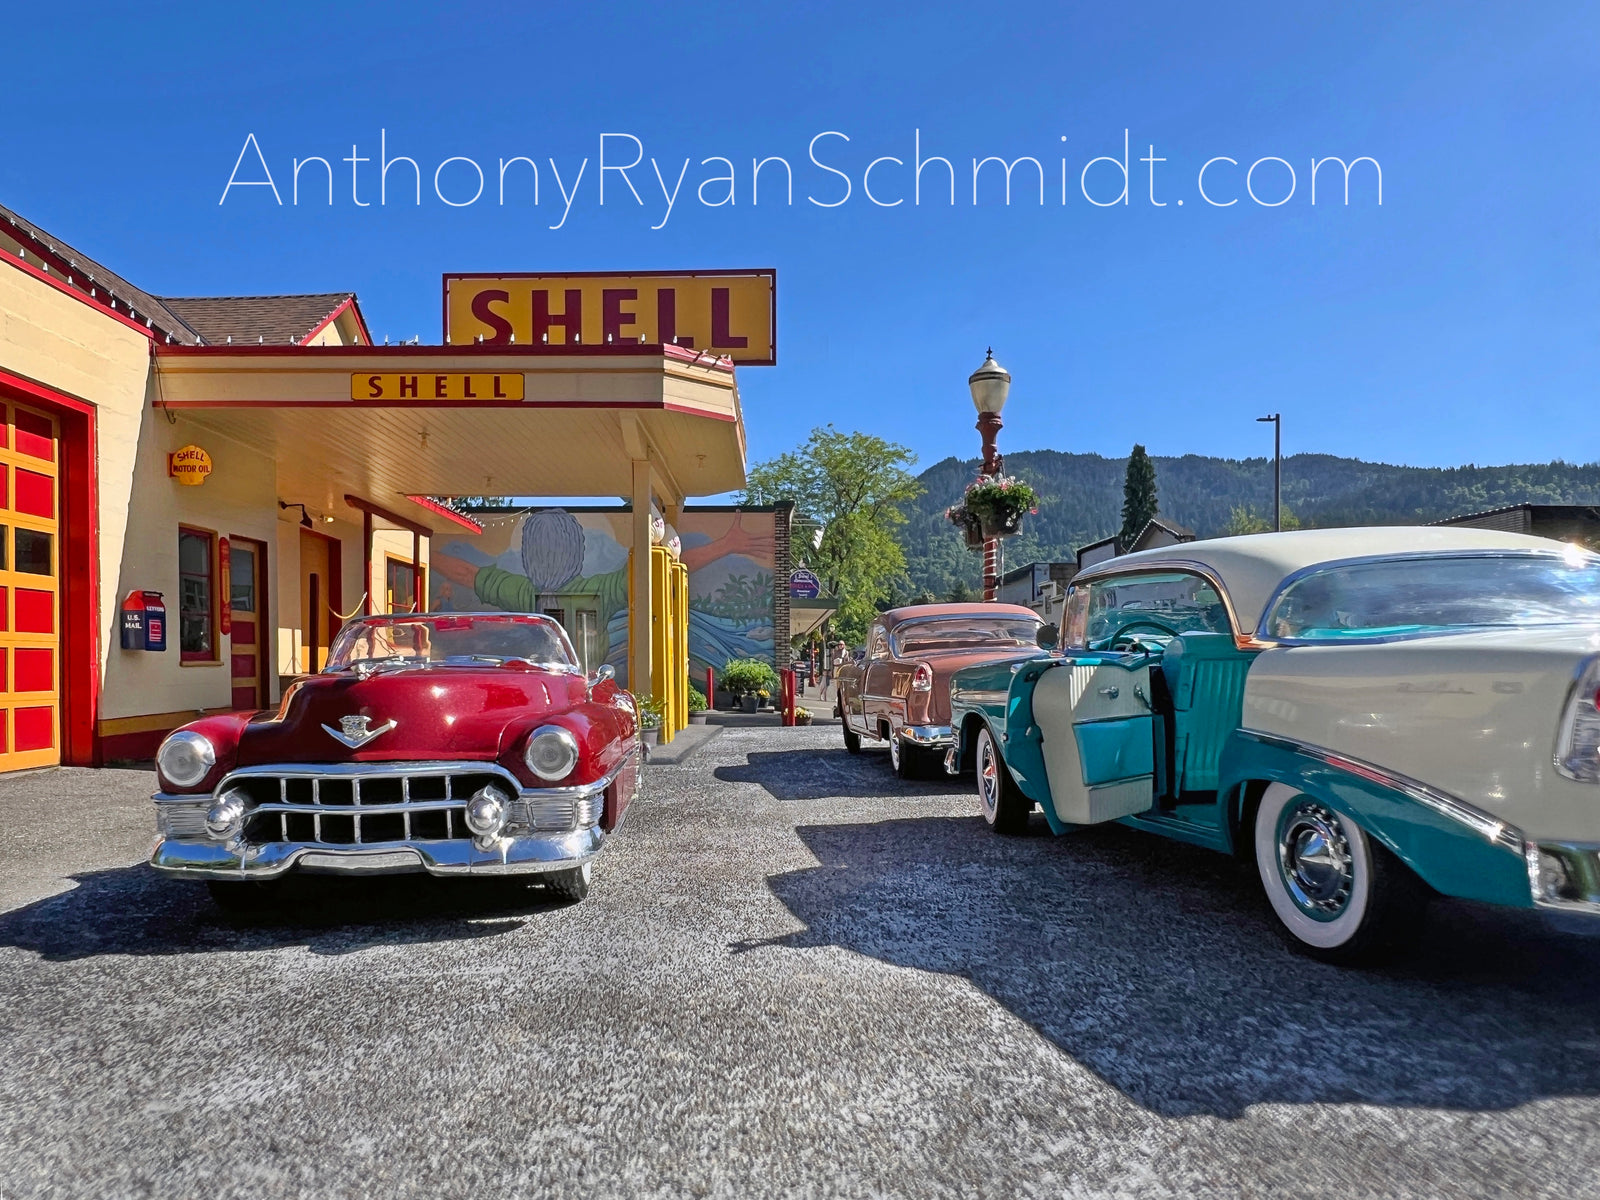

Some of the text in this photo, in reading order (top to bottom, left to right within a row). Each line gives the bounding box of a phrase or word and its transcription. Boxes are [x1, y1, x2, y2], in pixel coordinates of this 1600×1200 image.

[471, 287, 748, 348] SHELL
[368, 375, 507, 398] SHELL
[177, 450, 205, 462] SHELL
[173, 465, 211, 473] MOTOR OIL
